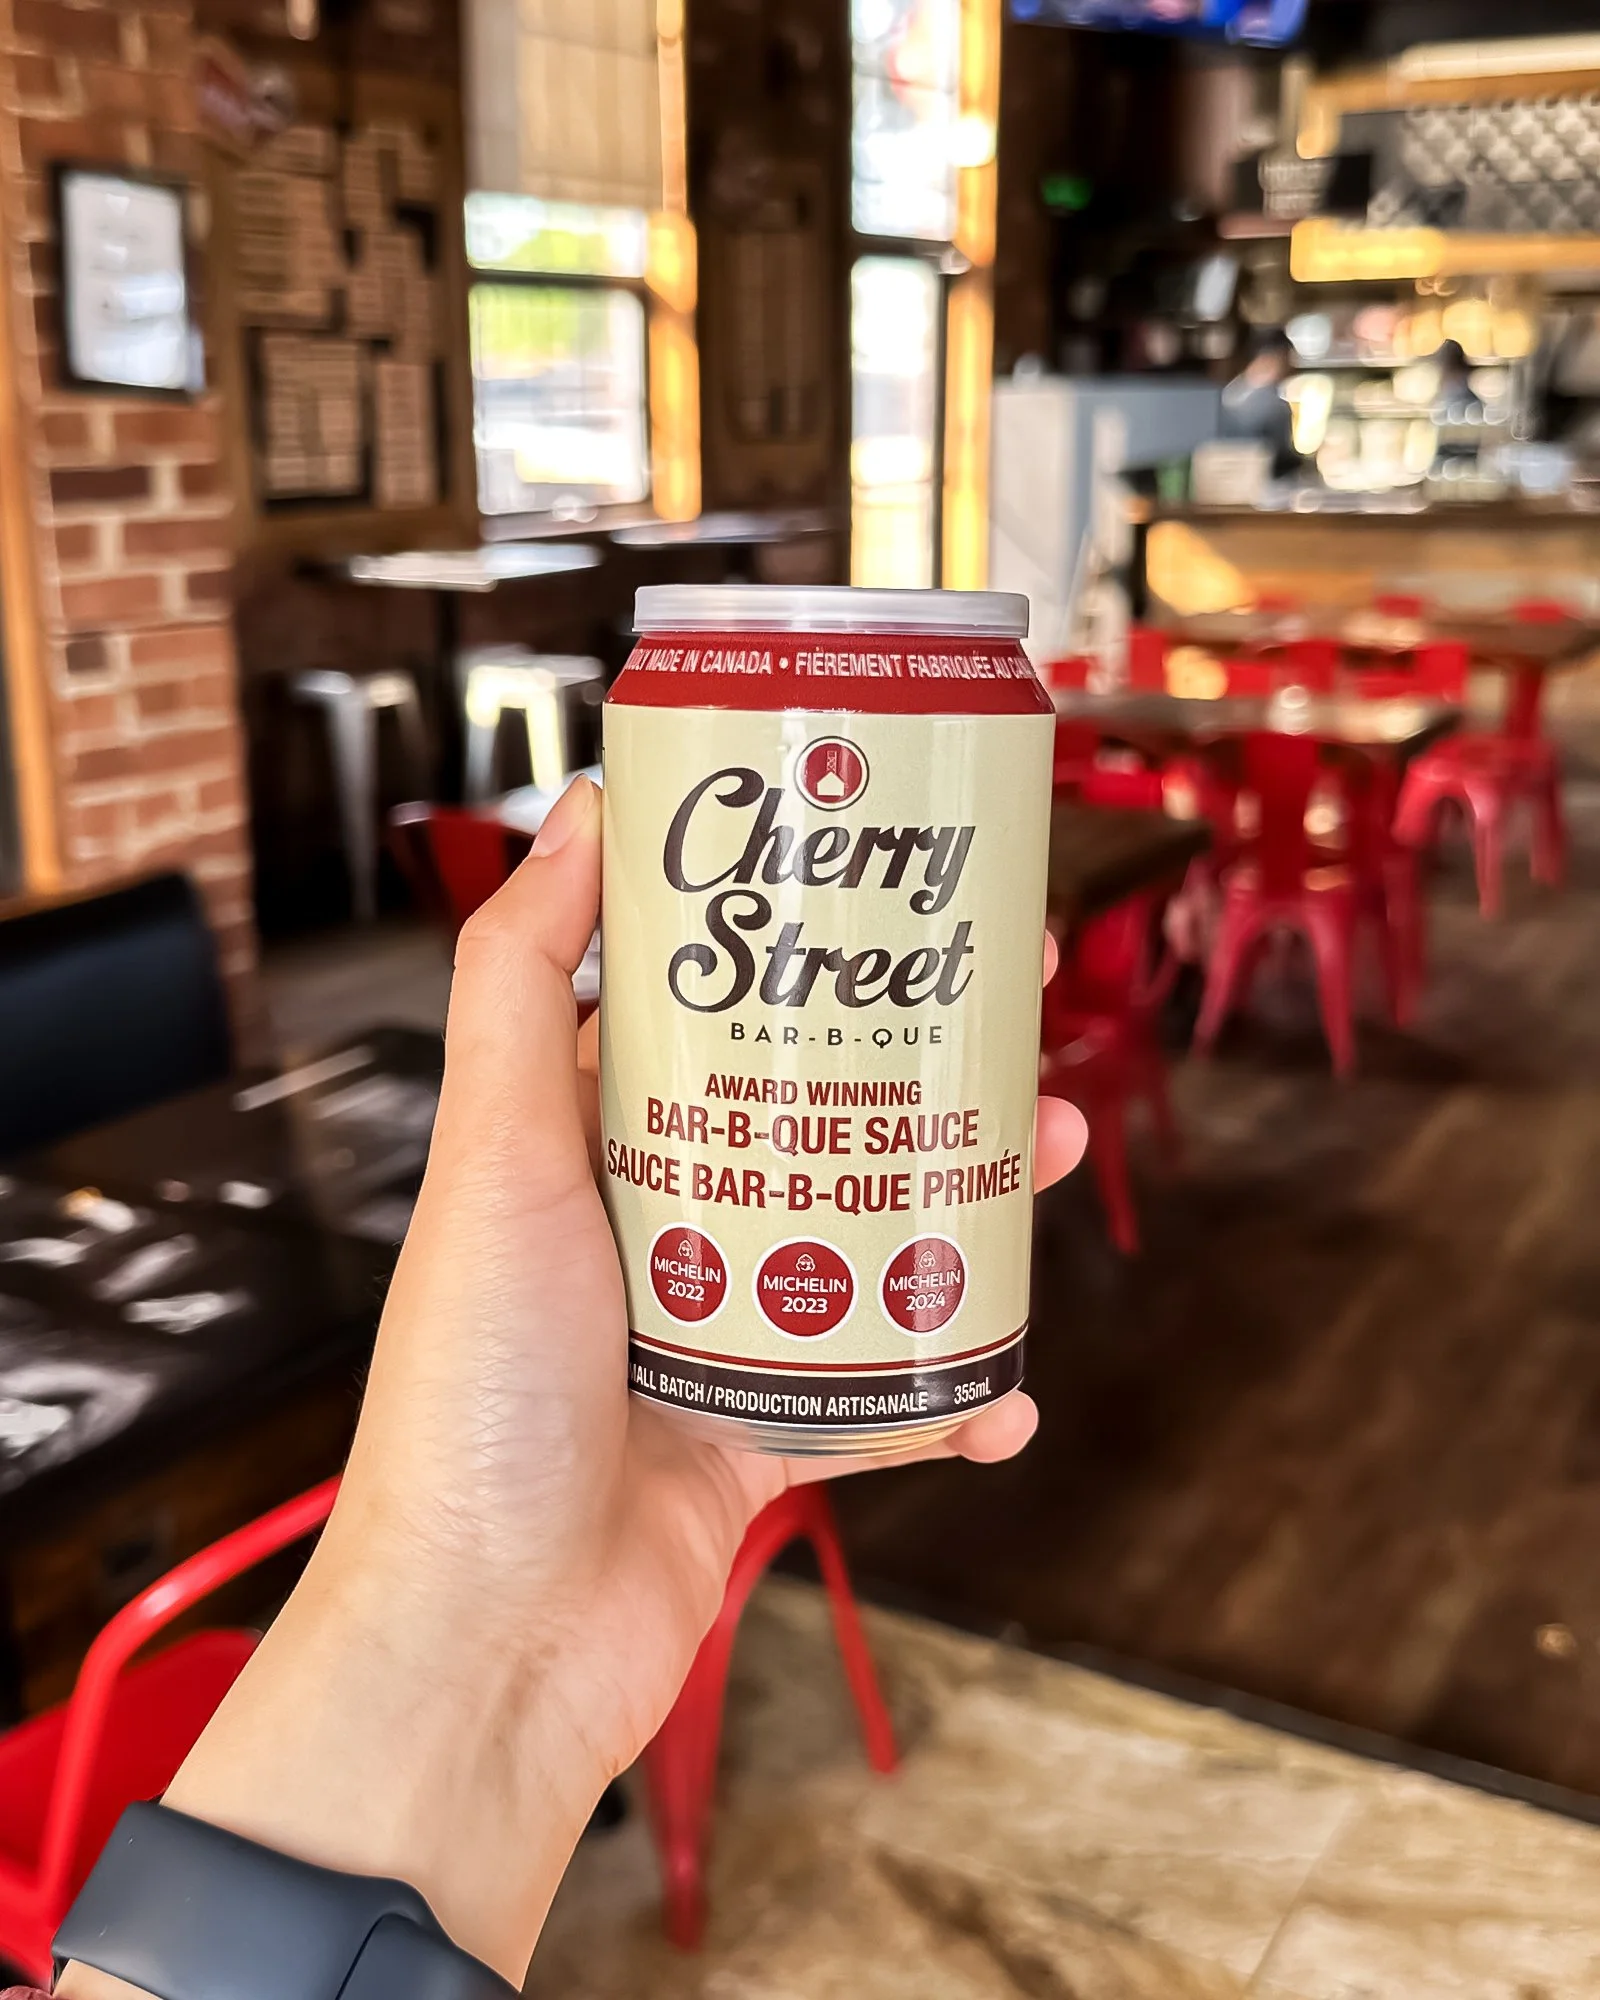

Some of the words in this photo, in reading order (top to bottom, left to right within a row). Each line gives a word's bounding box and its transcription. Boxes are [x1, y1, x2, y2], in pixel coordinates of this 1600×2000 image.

[646, 649, 684, 672] MADE
[682, 649, 700, 673] IN
[700, 650, 772, 675] CANADA
[663, 767, 976, 915] Cherry
[668, 889, 975, 1013] Street
[730, 1022, 942, 1048] BAR-B-QUE
[705, 1073, 798, 1105] AWARD
[806, 1080, 922, 1107] WINNING
[647, 1097, 851, 1157] BAR-B-QUE
[864, 1109, 979, 1155] SAUCE
[608, 1138, 680, 1196] SAUCE
[692, 1163, 911, 1216] BAR-B-QUE
[923, 1148, 1021, 1209] PRIMÉE
[654, 1256, 721, 1284] MICHELIN
[889, 1269, 961, 1292] MICHELIN
[667, 1279, 705, 1302] 2022
[763, 1275, 847, 1293] MICHELIN
[781, 1296, 828, 1314] 2023
[905, 1292, 946, 1311] 2024
[826, 1391, 928, 1417] ARTISANALE
[954, 1376, 992, 1405] 355mL
